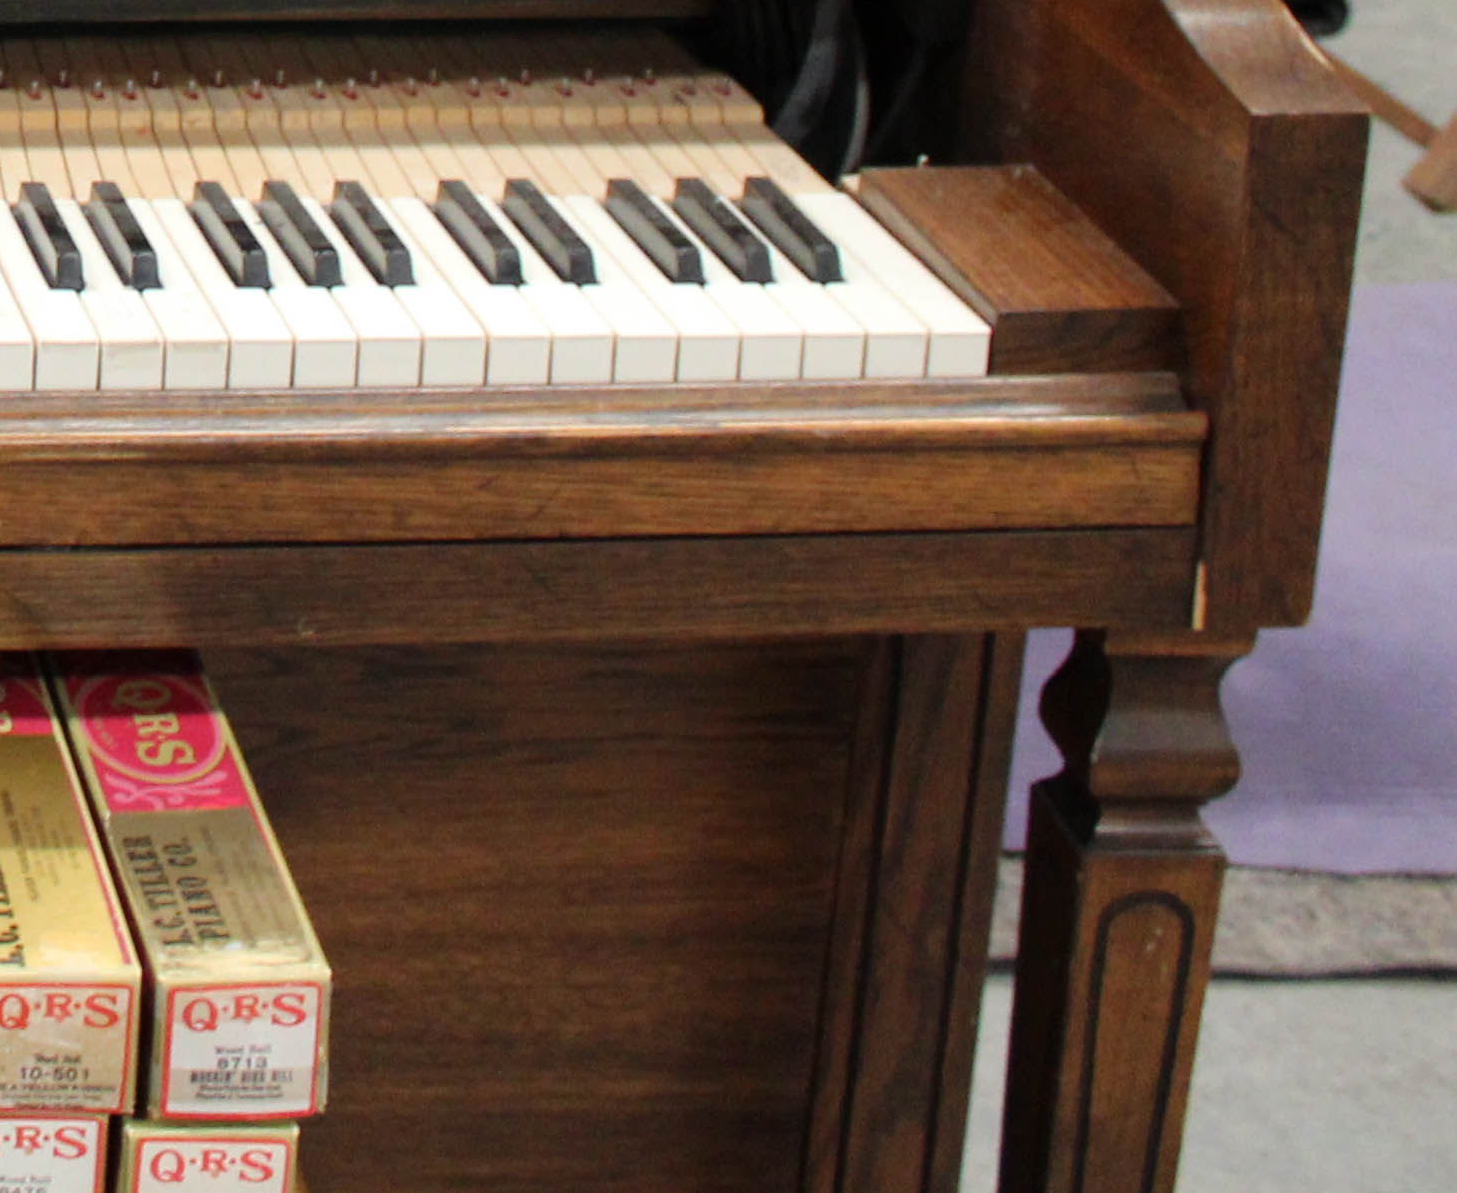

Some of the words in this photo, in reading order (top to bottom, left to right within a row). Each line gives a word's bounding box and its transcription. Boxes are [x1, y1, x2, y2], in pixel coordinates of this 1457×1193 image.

[121, 835, 178, 910] TILLER
[162, 836, 198, 868] CO.
[175, 875, 231, 943] PIANO
